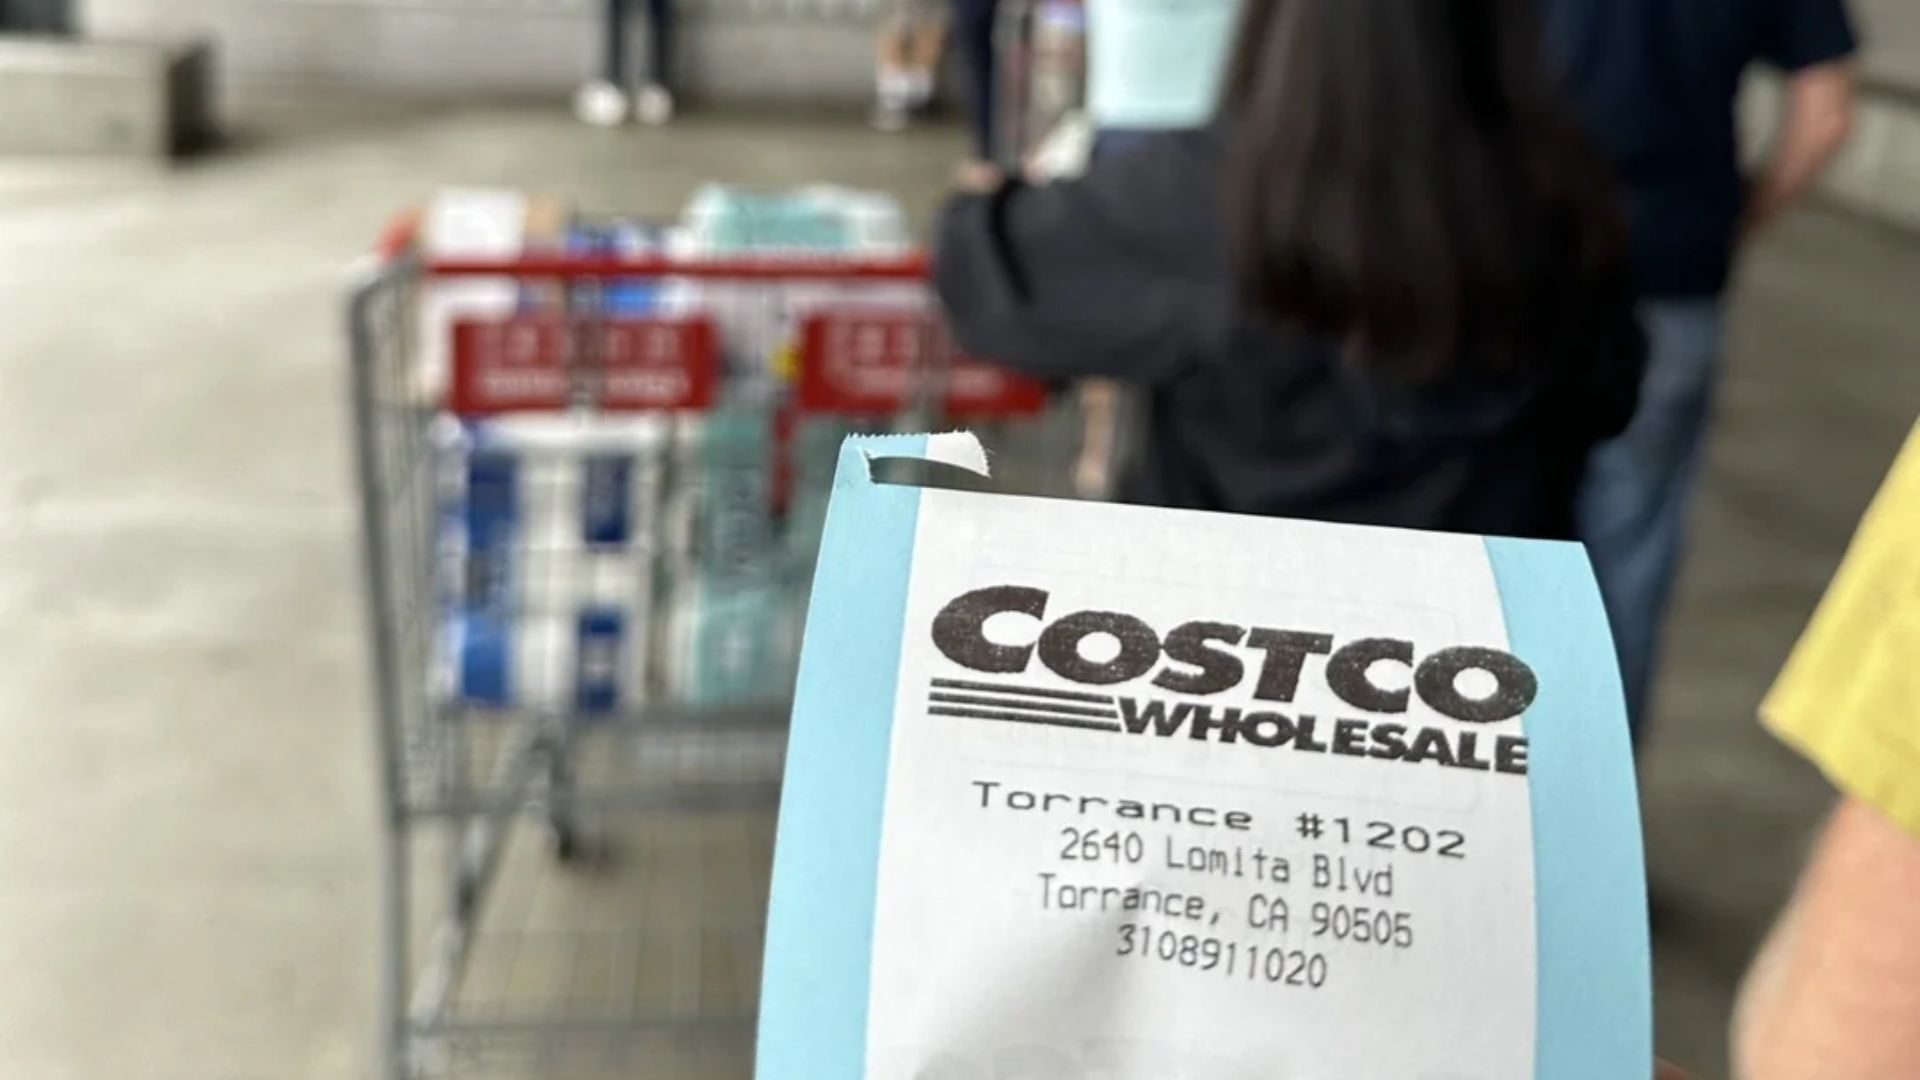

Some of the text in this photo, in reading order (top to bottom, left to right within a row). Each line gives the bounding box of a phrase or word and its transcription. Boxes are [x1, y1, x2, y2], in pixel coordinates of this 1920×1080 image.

[930, 584, 1538, 723] COSTCO
[1119, 697, 1529, 775] WHOLESALE
[971, 781, 1467, 860] Torrance #1202
[1060, 827, 1394, 898] 2640 Lomita Blvd
[1038, 873, 1414, 949] Torrance, CA 90505
[1116, 923, 1328, 990] 3108911020
